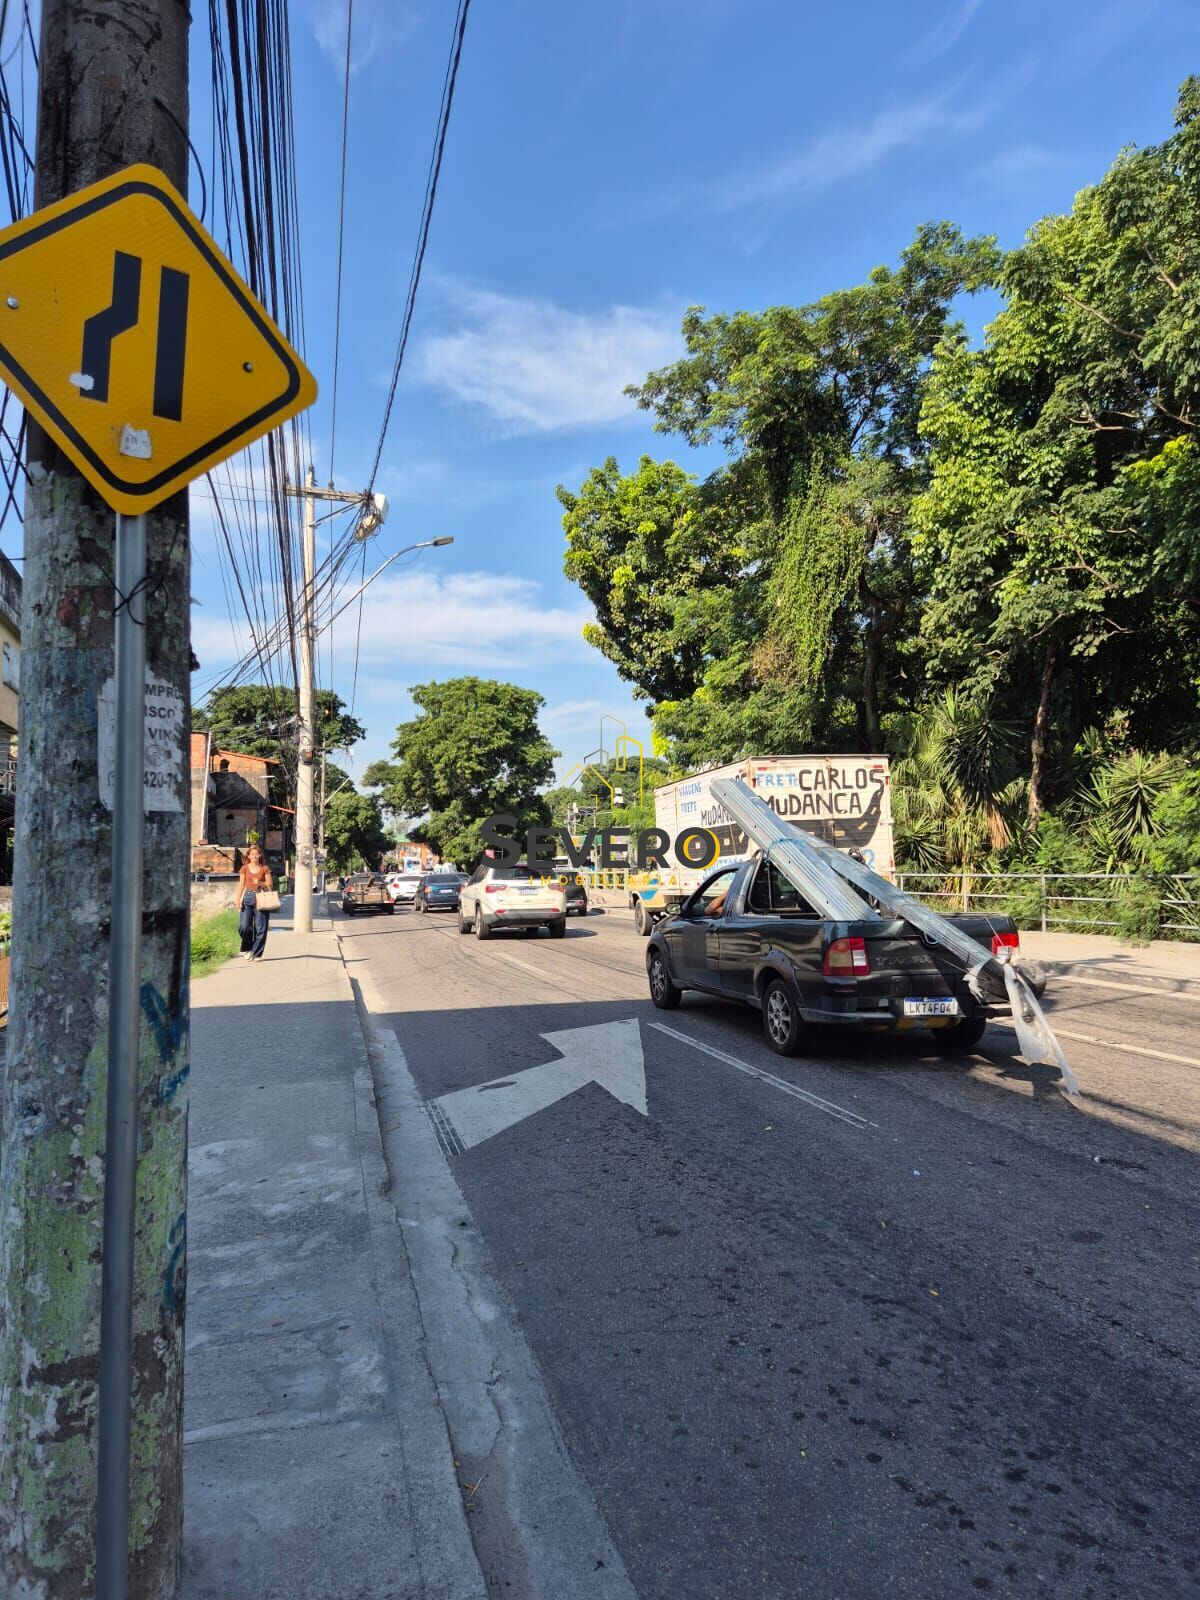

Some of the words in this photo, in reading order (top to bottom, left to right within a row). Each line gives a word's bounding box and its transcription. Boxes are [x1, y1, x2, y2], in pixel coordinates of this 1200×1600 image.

[144, 684, 182, 700] MPRO
[798, 767, 885, 792] CARLOS
[700, 803, 733, 827] MUDAN
